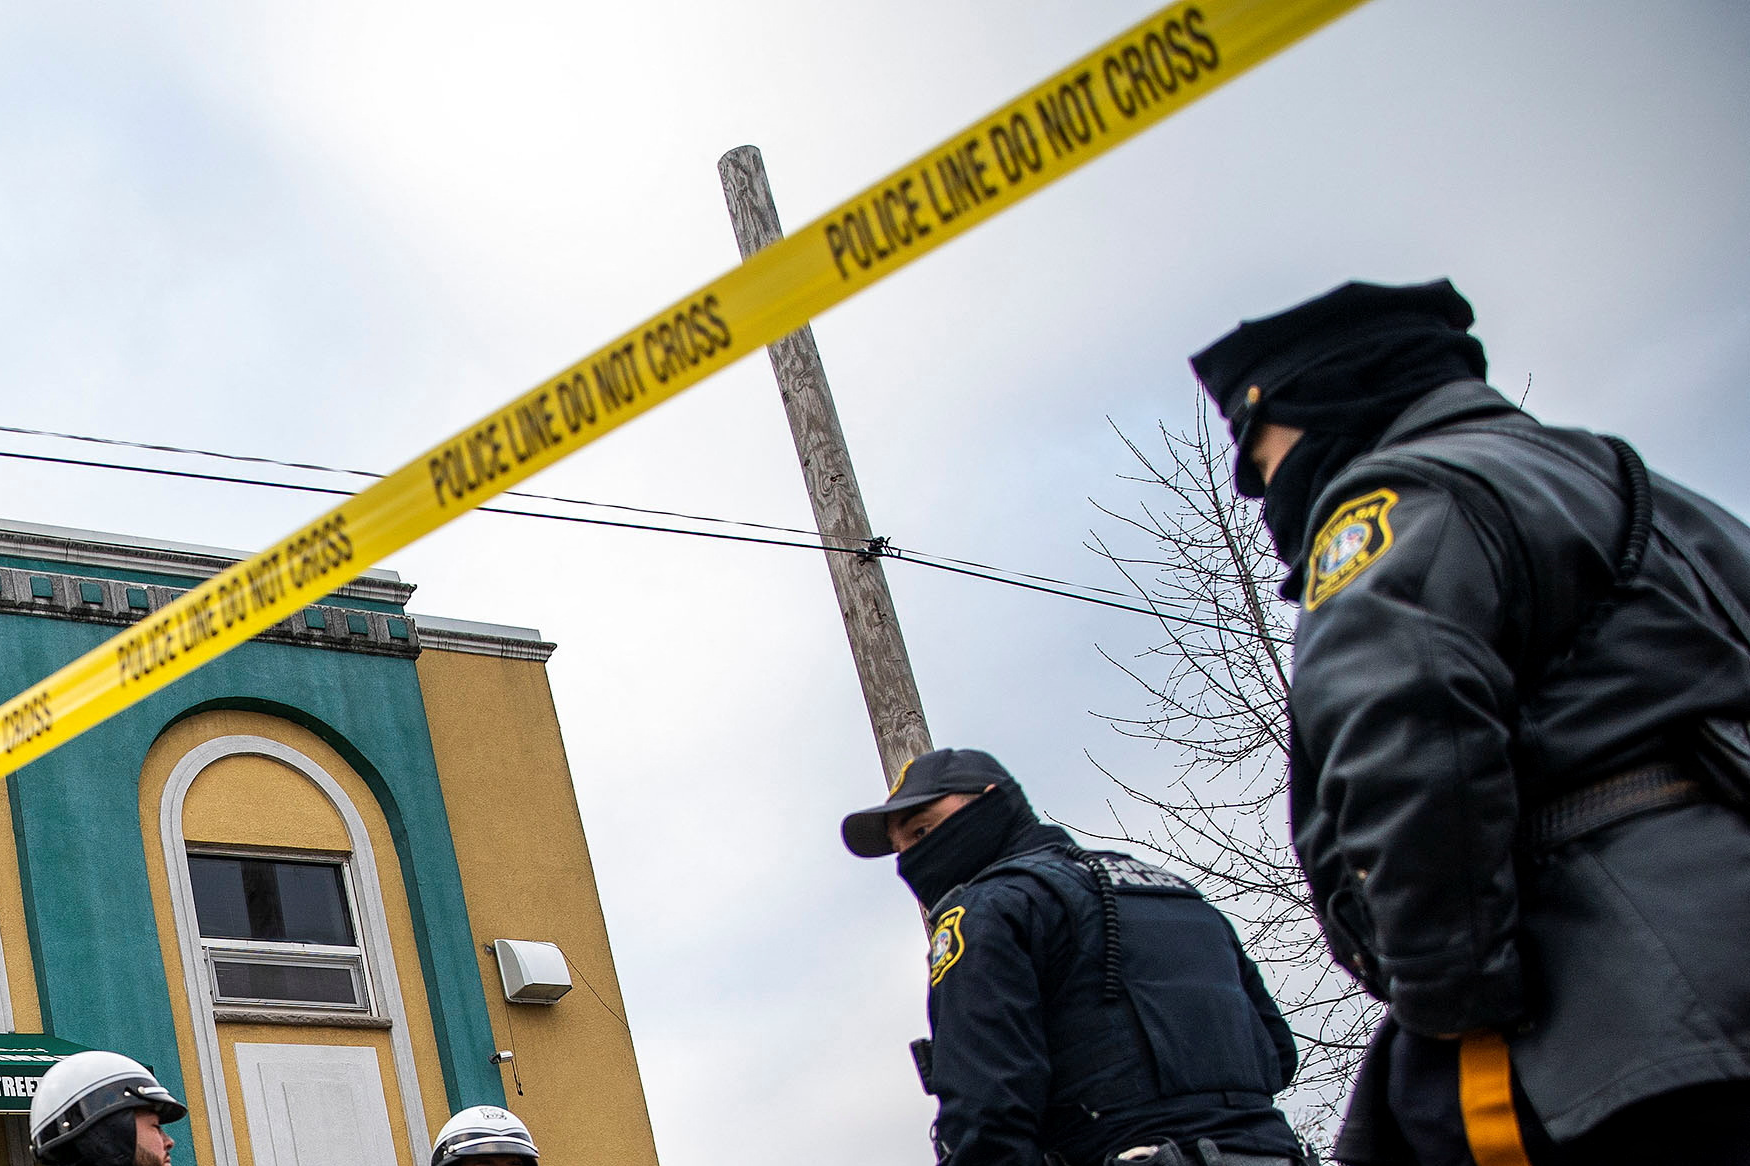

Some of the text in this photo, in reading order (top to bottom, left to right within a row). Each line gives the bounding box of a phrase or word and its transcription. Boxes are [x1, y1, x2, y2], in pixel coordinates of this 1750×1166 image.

[825, 6, 1220, 281] POLICE LINE DO NOT CROSS
[428, 293, 732, 507] POLICE LINE DO NOT CROSS
[117, 513, 353, 688] POLICE LINE DO NOT CROSS
